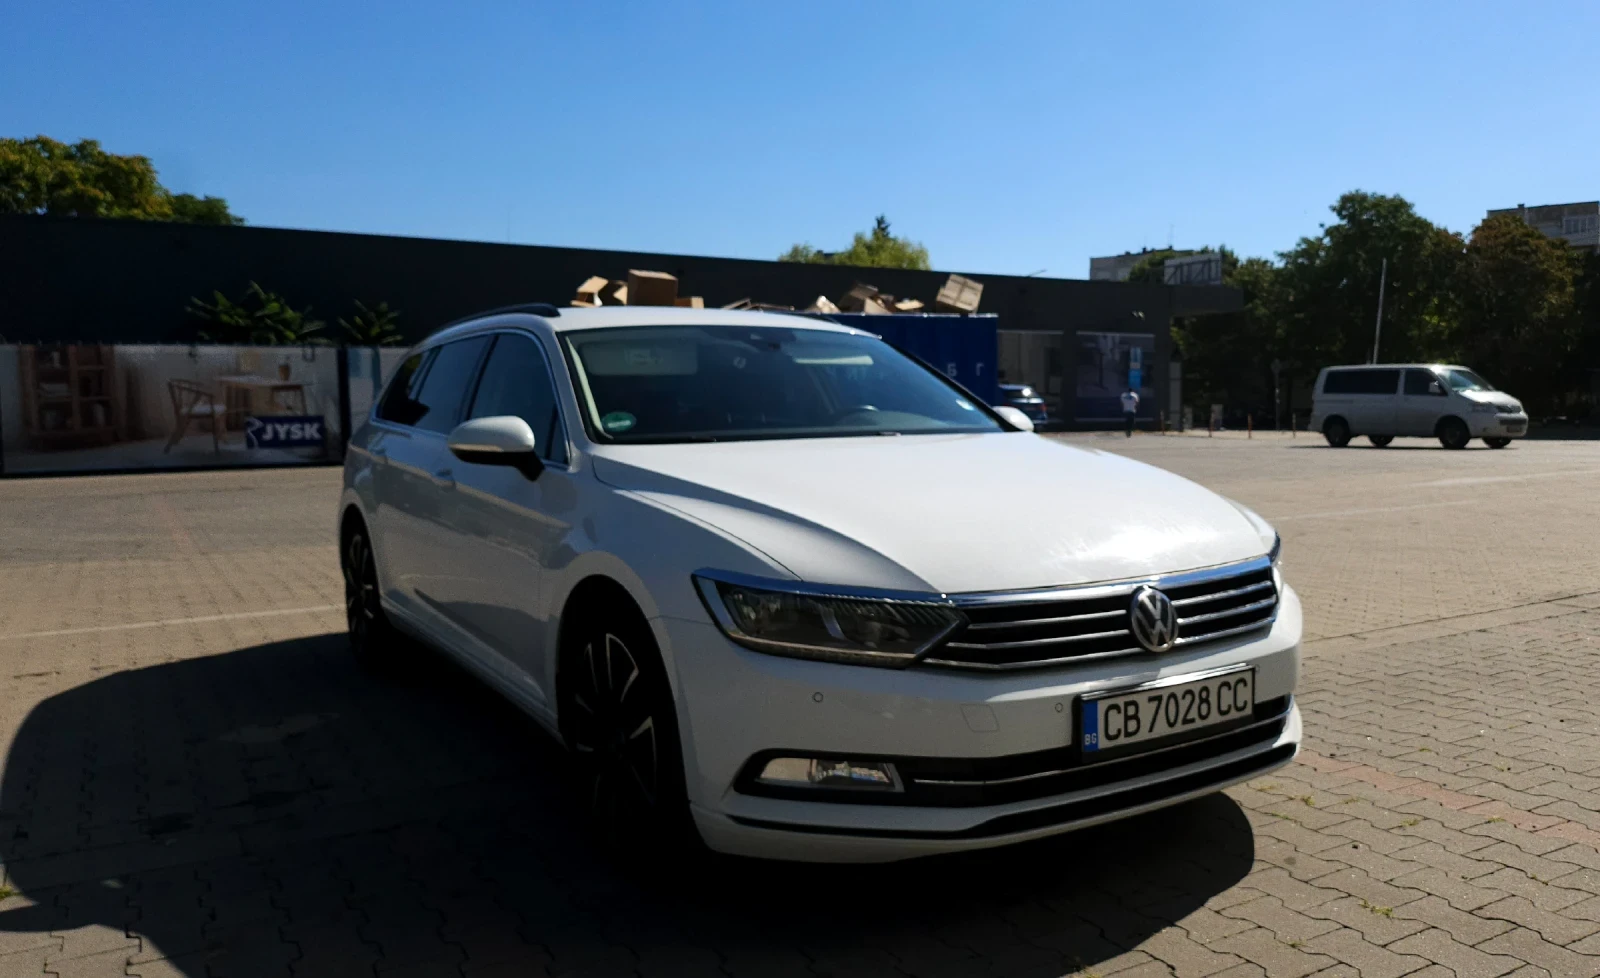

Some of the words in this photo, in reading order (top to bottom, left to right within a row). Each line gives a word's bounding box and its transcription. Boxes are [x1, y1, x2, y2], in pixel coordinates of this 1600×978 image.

[261, 422, 322, 441] JYSK
[1147, 685, 1211, 733] 7028
[1084, 732, 1097, 745] BG
